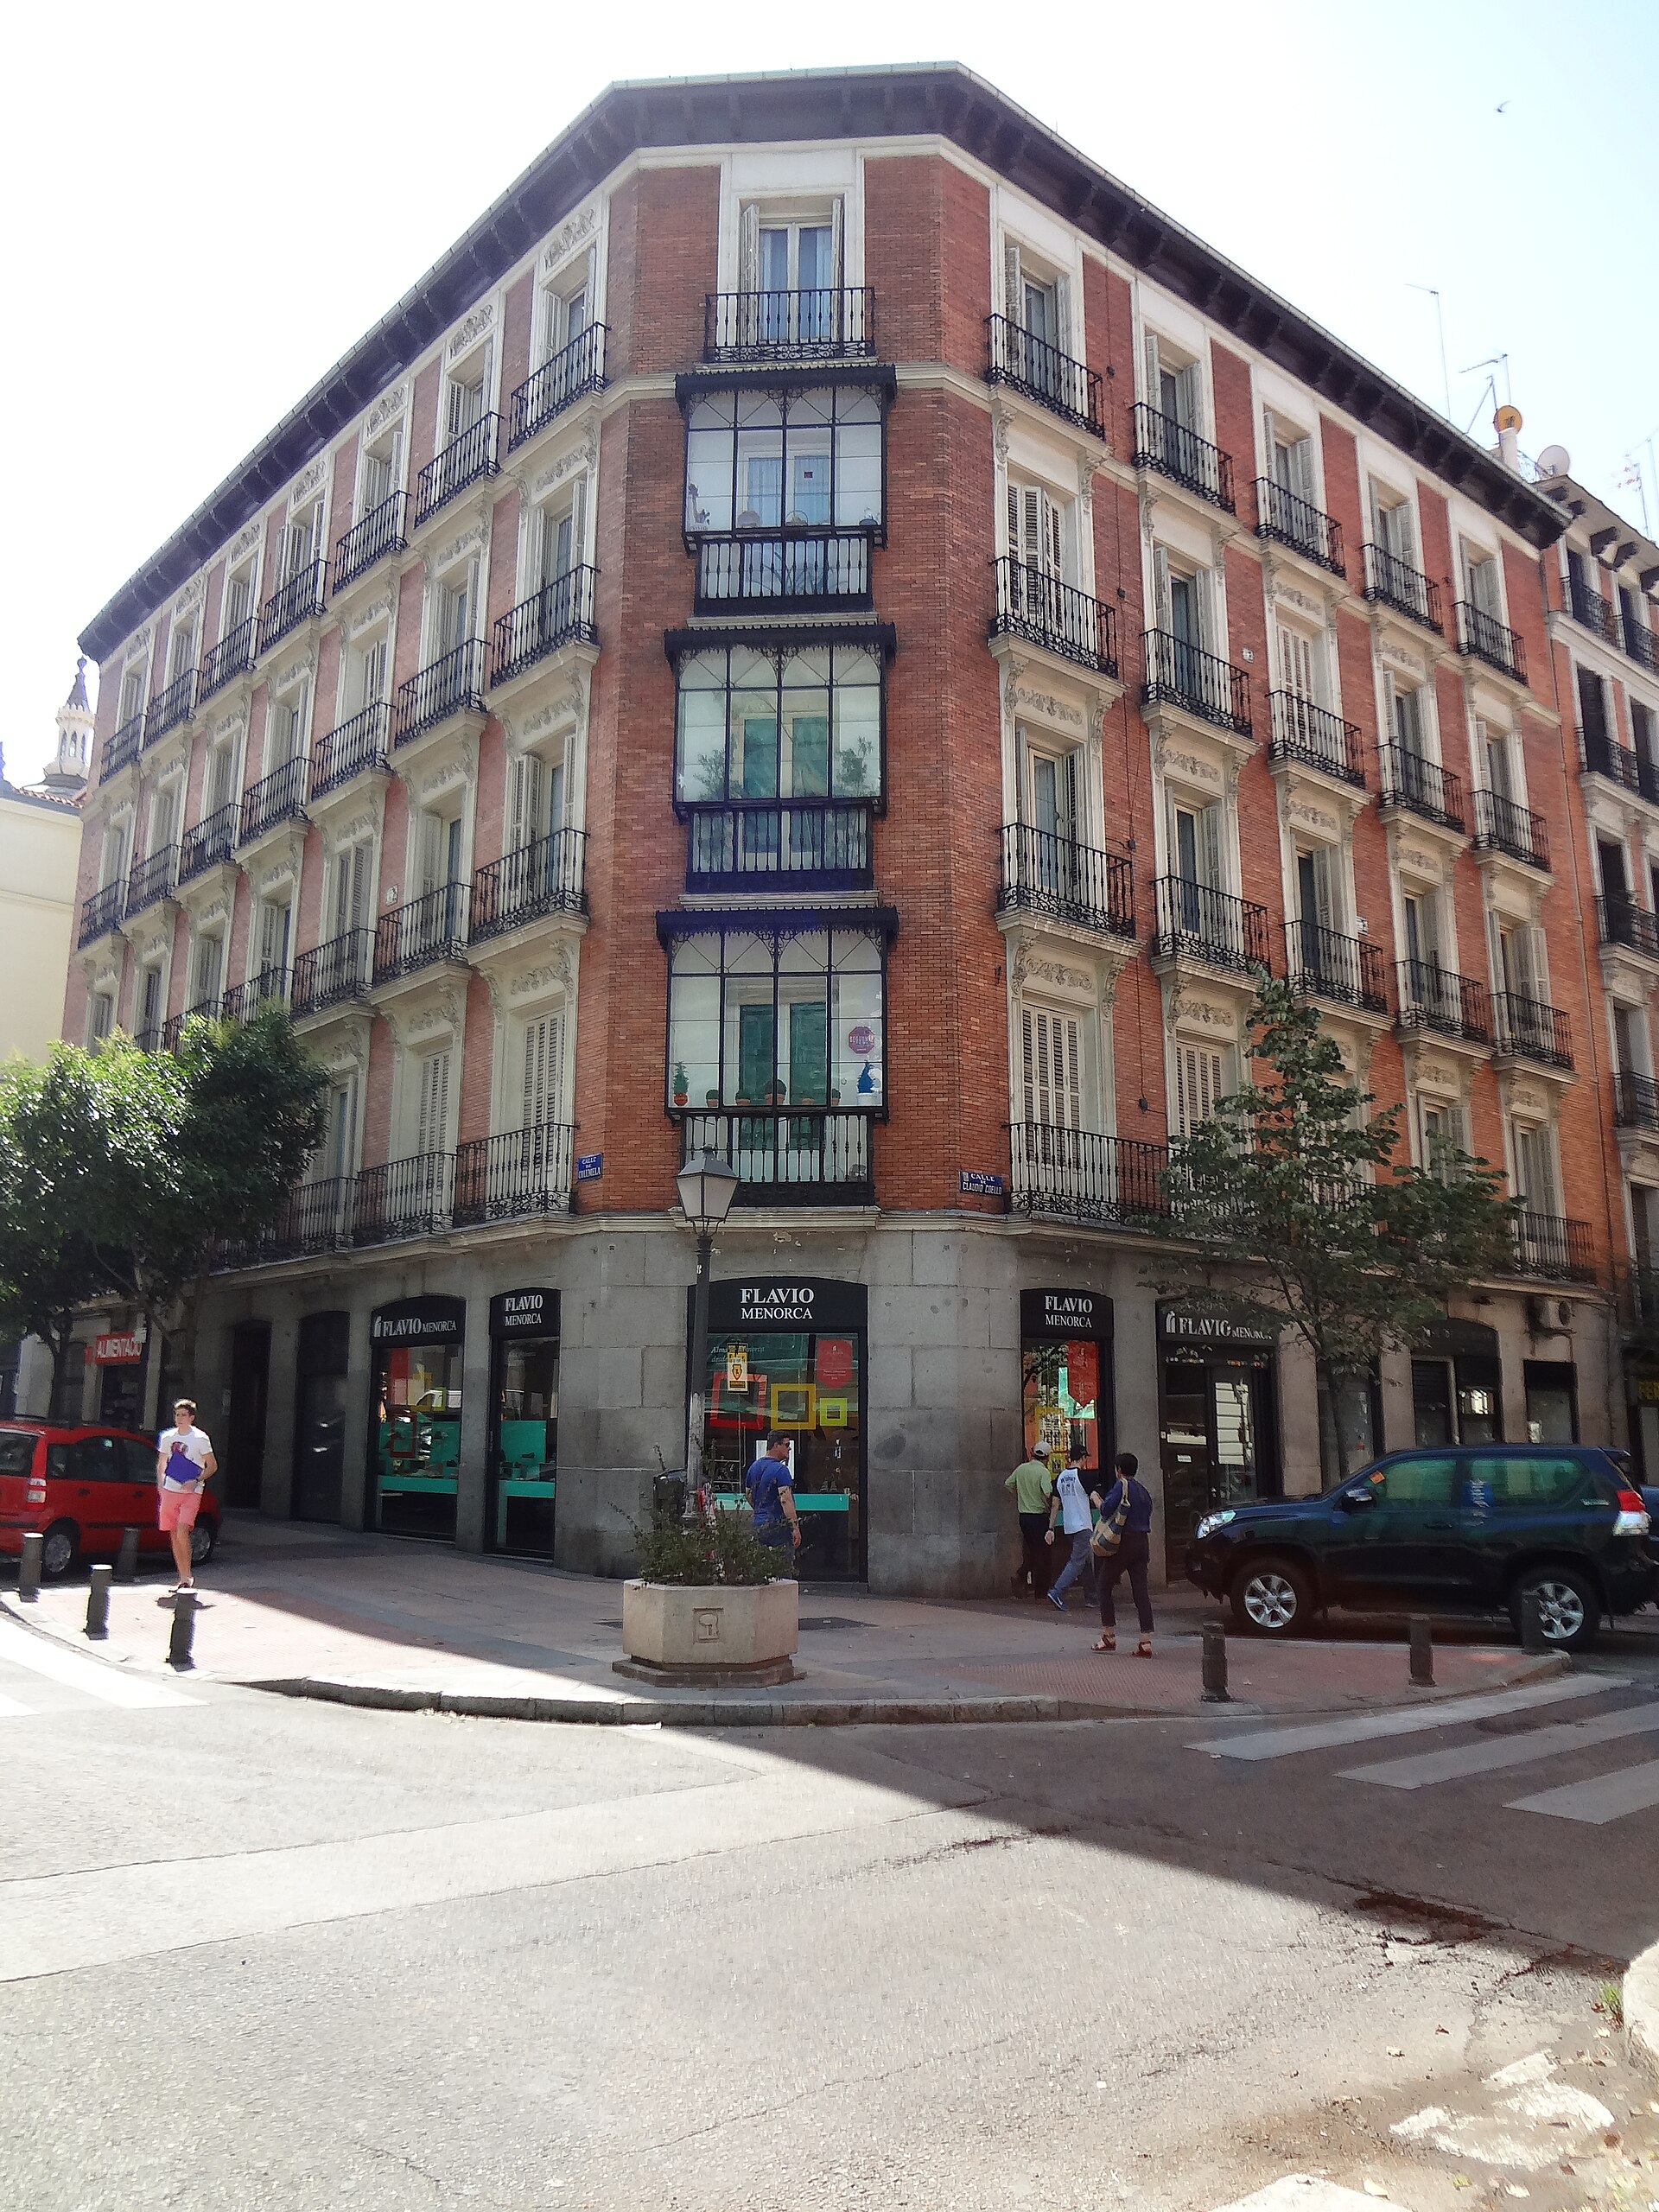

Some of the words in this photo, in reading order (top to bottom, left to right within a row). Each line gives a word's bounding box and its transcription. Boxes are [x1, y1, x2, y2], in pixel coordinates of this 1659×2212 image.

[579, 1166, 601, 1179] COLUMELA
[970, 1173, 995, 1182] CALLE
[963, 1181, 983, 1192] CLAUDIO
[985, 1185, 1002, 1195] COELLO
[505, 1294, 543, 1312] FLAVIO
[740, 1287, 815, 1304] FLAVIO
[1045, 1295, 1093, 1313] FLAVIO
[505, 1313, 543, 1326] MENORCA
[741, 1307, 813, 1319] MENORCA
[1045, 1313, 1092, 1328] MENORCA
[383, 1318, 422, 1337] FLAVIO
[423, 1320, 457, 1333] MENORCA
[1179, 1317, 1231, 1337] FLAVIO
